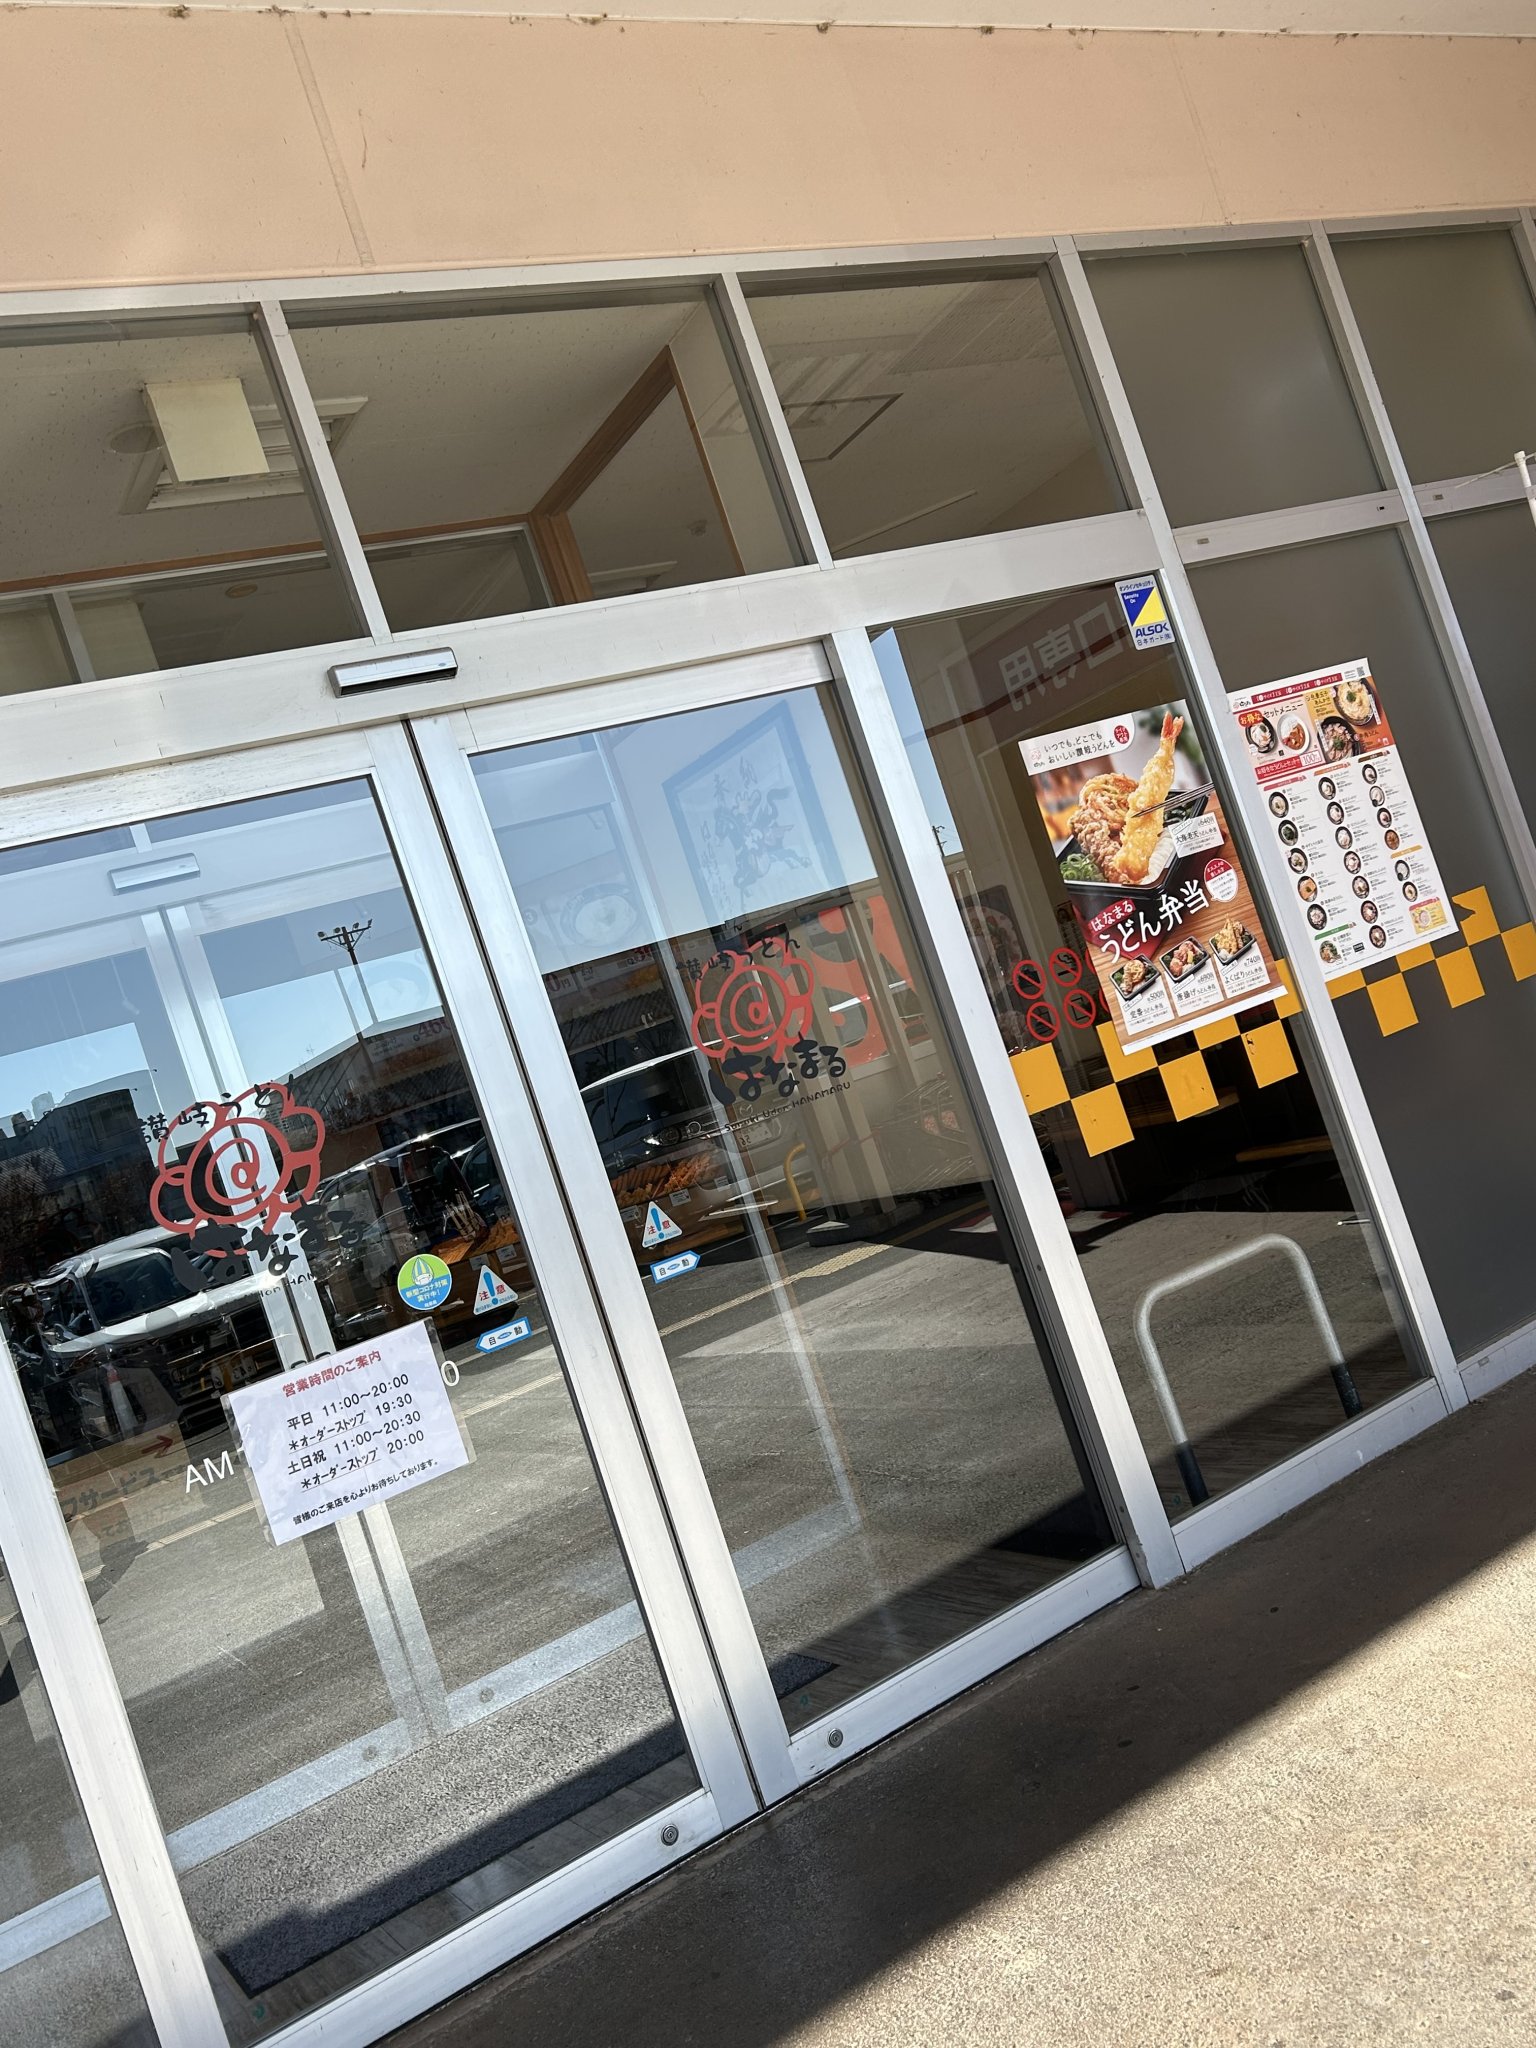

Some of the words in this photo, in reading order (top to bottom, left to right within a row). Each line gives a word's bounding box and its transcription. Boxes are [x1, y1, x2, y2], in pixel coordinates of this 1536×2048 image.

[1135, 622, 1170, 639] ALSOK
[1263, 703, 1304, 719] セットメニュー
[1090, 900, 1134, 932] はなまる
[1098, 879, 1210, 964] うどん弁当
[707, 1031, 847, 1106] はなまる
[169, 1196, 364, 1293] はなまる
[282, 1350, 382, 1398] 営業時間のご案内
[286, 1410, 315, 1431] 平日
[321, 1372, 410, 1417] 11:00～20:00
[375, 1392, 413, 1417] 19:30
[287, 1449, 327, 1476] 土日祝
[333, 1409, 422, 1455] 11:00～20:30
[386, 1429, 425, 1455] 20:00
[185, 1450, 235, 1494] AM
[292, 1458, 439, 1526] 皆様のご来店を心よりお待ちしております。
